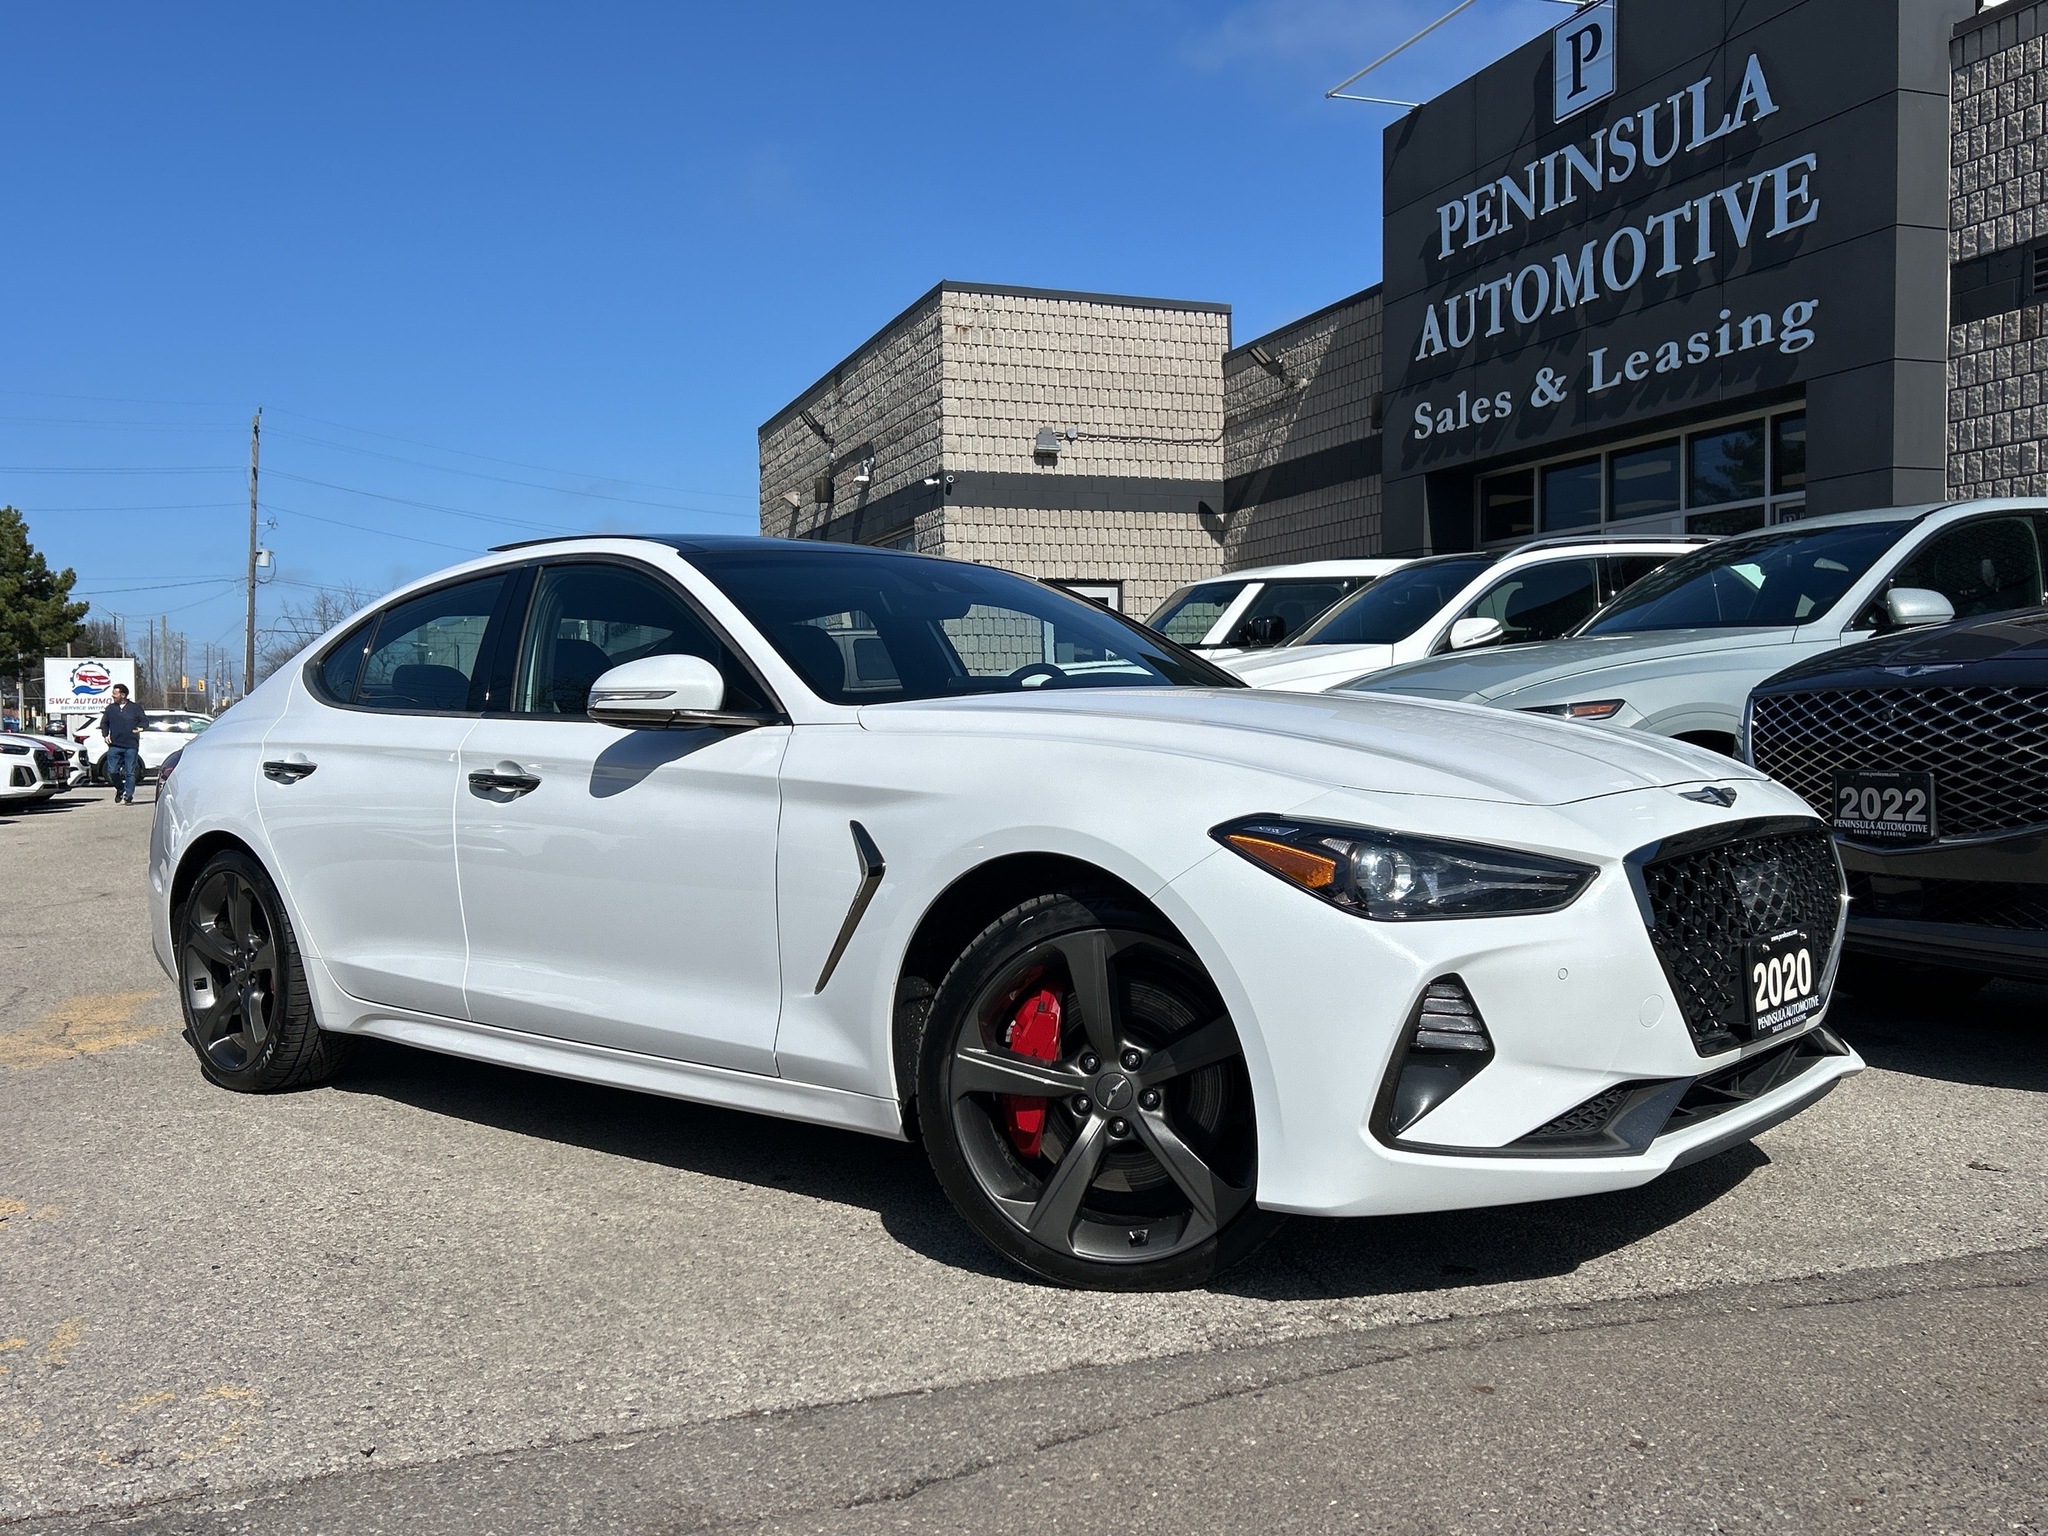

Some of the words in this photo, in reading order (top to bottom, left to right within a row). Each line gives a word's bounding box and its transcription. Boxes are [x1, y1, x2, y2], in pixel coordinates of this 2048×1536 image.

[1565, 22, 1603, 100] P
[1436, 53, 1780, 261] PENINSULA
[1414, 152, 1820, 362] AUTOMOTIVE
[1412, 390, 1513, 440] Sales
[1530, 366, 1568, 408] &
[1586, 299, 1819, 394] Leasing
[73, 697, 113, 705] AUTOMO
[1833, 818, 1876, 830] PENINSULA
[1876, 821, 1928, 833] AUTOMOTIVE
[1840, 787, 1926, 821] 2022
[1883, 830, 1907, 838] LEASING
[1753, 948, 1811, 1012] 2020
[1757, 1006, 1786, 1030] PENINSULA
[1785, 995, 1819, 1018] AUTOMOTIVE
